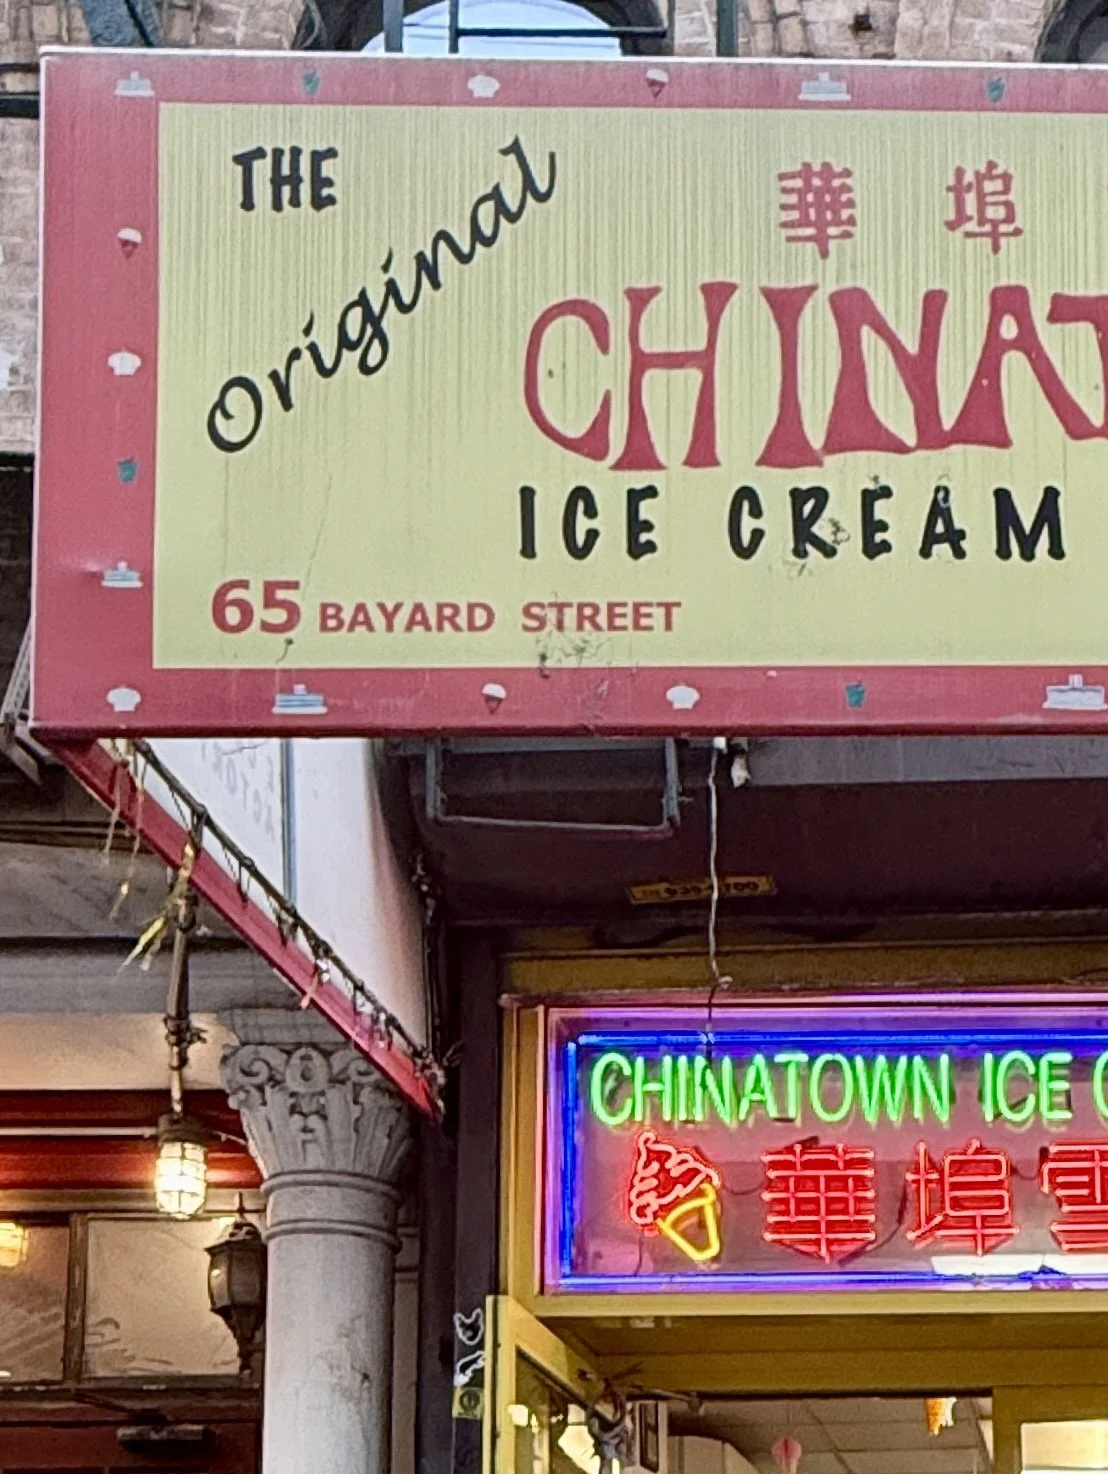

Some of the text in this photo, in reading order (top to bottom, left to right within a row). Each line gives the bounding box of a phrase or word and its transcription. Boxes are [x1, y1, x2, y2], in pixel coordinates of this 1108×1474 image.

[232, 146, 338, 213] THE
[205, 134, 557, 454] Original
[518, 484, 660, 560] ICE
[727, 484, 1066, 562] CREAM
[211, 579, 682, 634] 65 BAYARD STREET
[590, 1051, 951, 1125] CHINATOWN
[981, 1051, 1075, 1123] ICE
